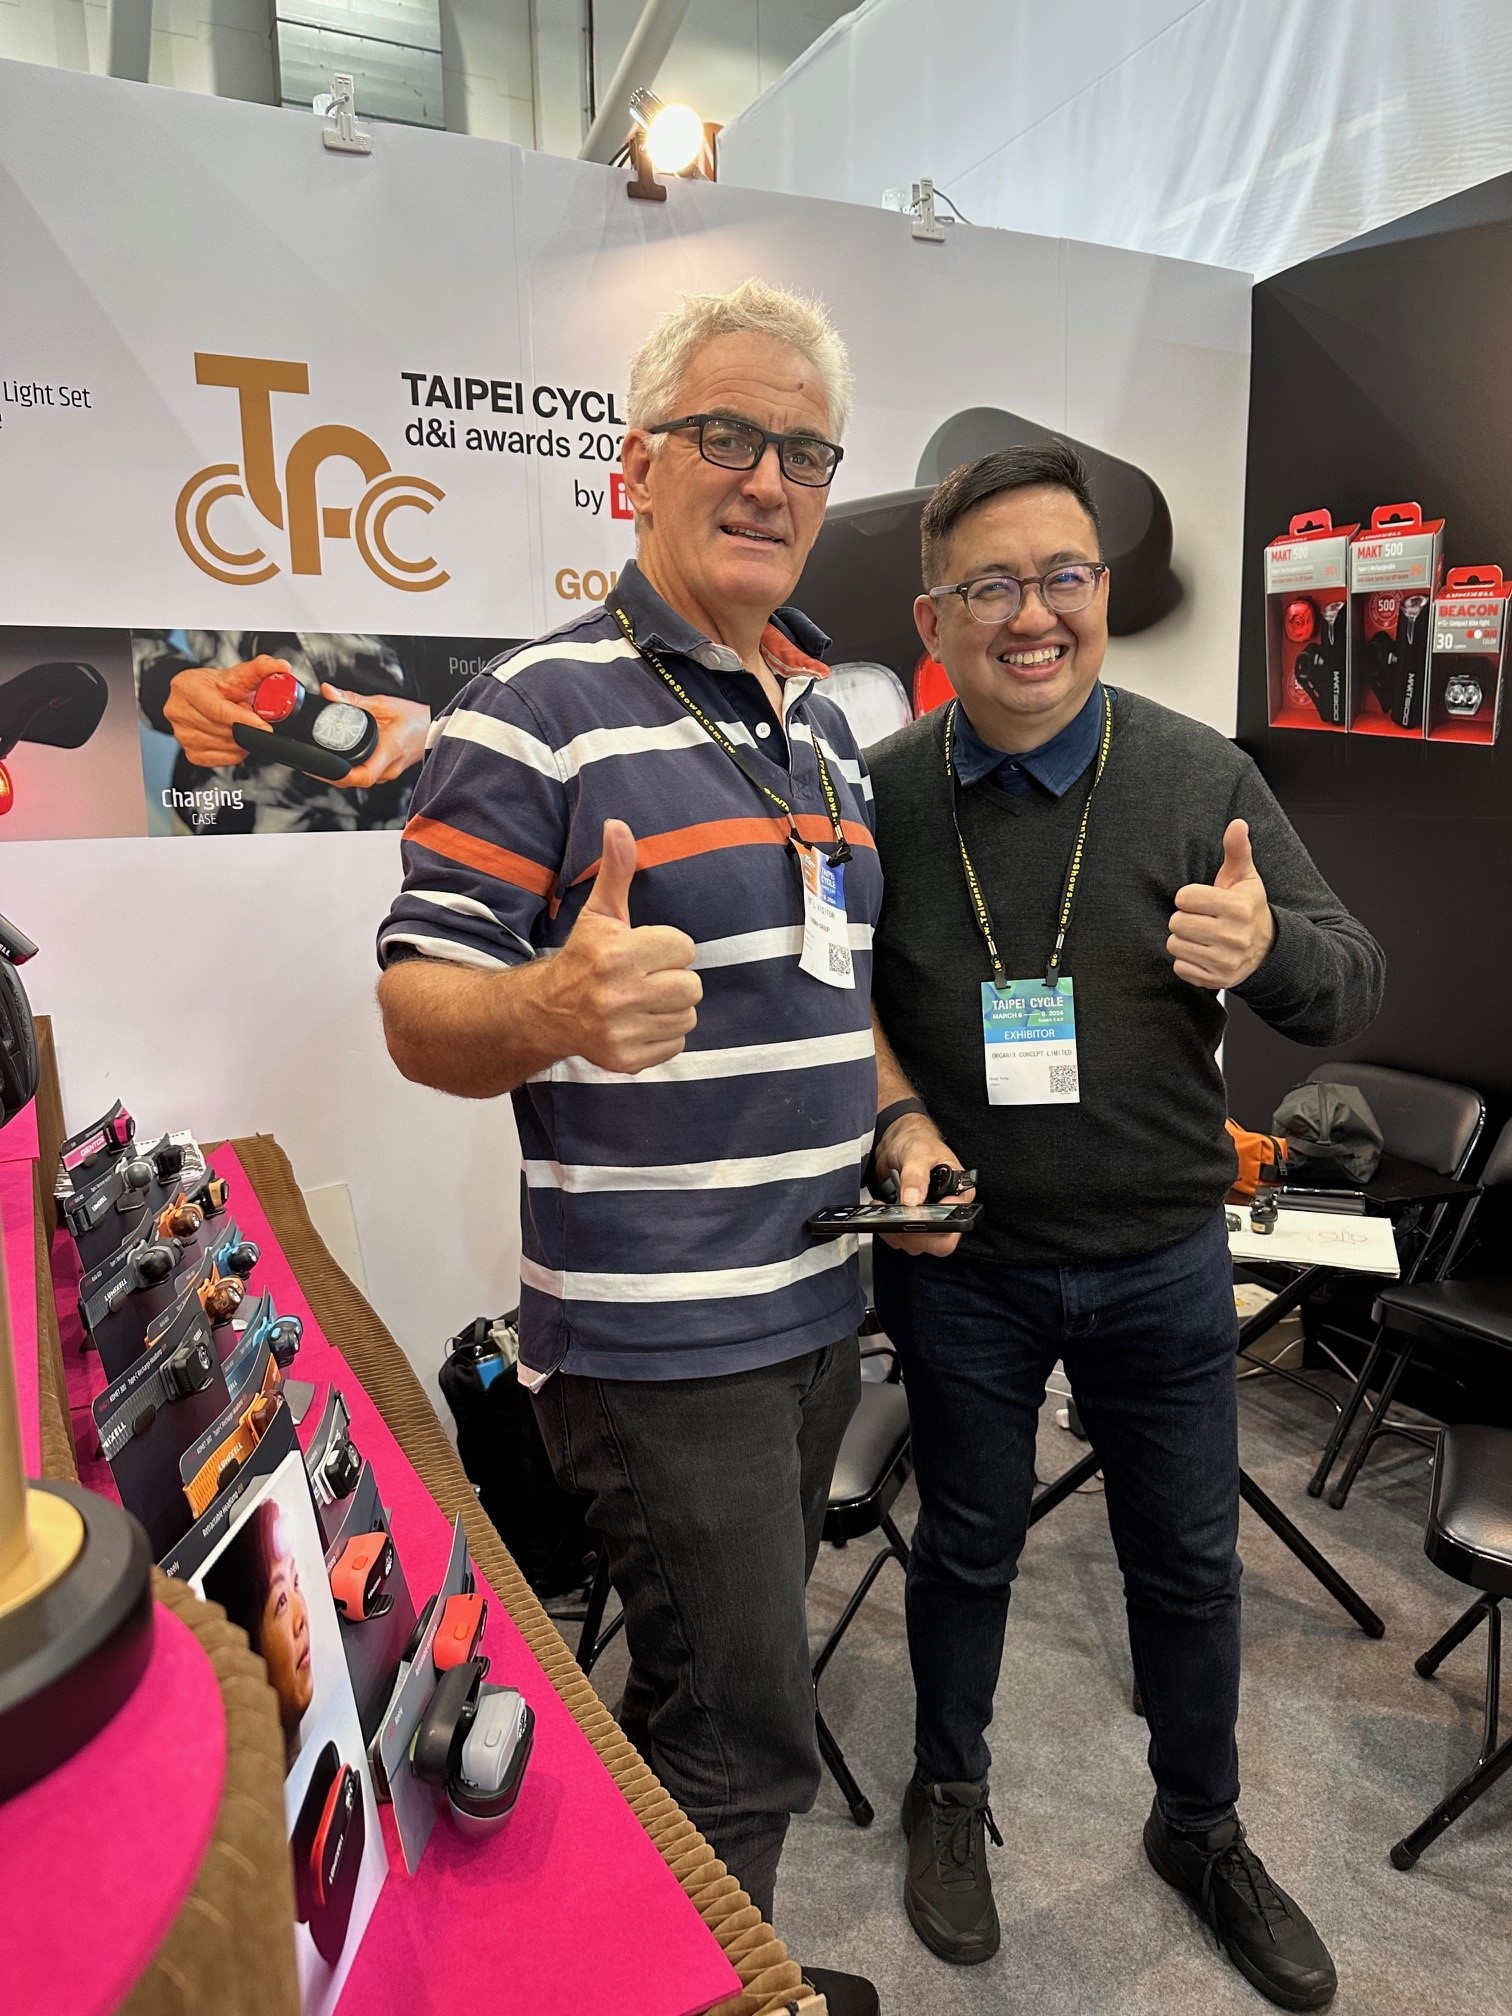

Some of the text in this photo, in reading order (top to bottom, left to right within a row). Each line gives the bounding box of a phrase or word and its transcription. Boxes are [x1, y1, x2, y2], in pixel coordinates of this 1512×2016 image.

[3, 380, 92, 408] Light Set
[401, 372, 627, 425] TAIPEI CYCL
[405, 417, 456, 449] d&i
[465, 427, 571, 458] awards
[574, 479, 604, 515] by
[1271, 548, 1291, 563] MAKT
[1357, 541, 1404, 559] MAKT 500
[1378, 599, 1396, 612] 500
[1439, 603, 1499, 617] BEACON
[1436, 633, 1454, 650] 30
[449, 656, 486, 675] Pock
[161, 787, 244, 810] Charging
[192, 813, 218, 826] CASE
[992, 997, 1064, 1010] TAIPEI CYCLE
[1004, 1029, 1056, 1040] EXHIBITOR
[1019, 1050, 1044, 1058] CONCEPT
